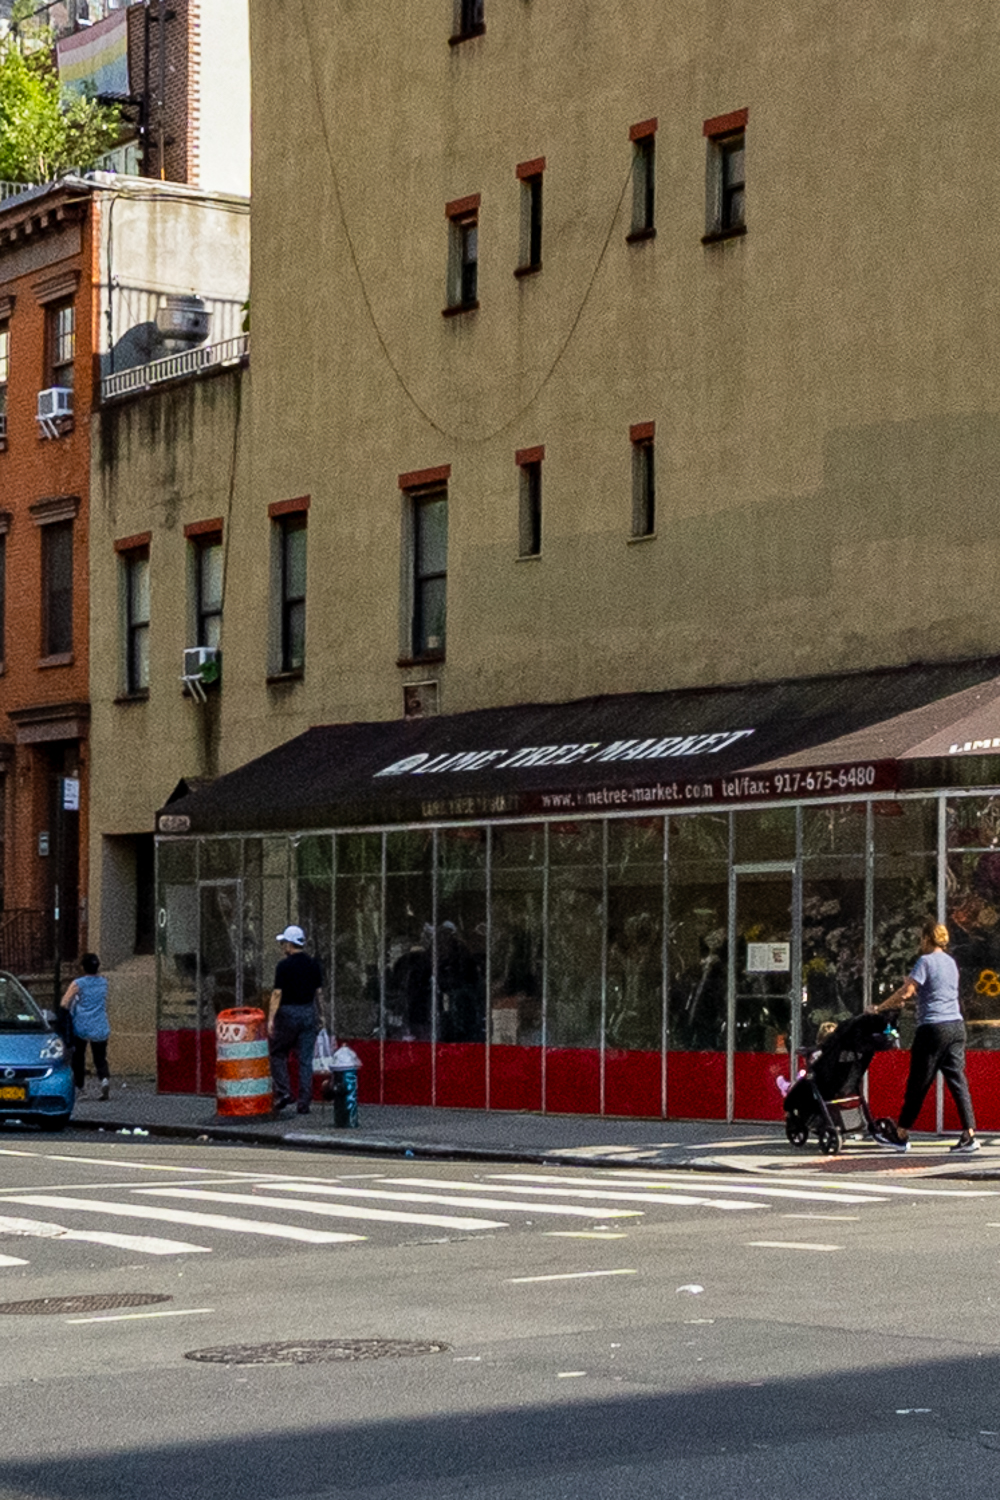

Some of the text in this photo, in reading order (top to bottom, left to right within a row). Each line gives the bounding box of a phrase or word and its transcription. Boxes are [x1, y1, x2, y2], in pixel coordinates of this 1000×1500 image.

[410, 728, 755, 775] LIME TREE MARKET
[774, 766, 876, 793] 917-675-6480
